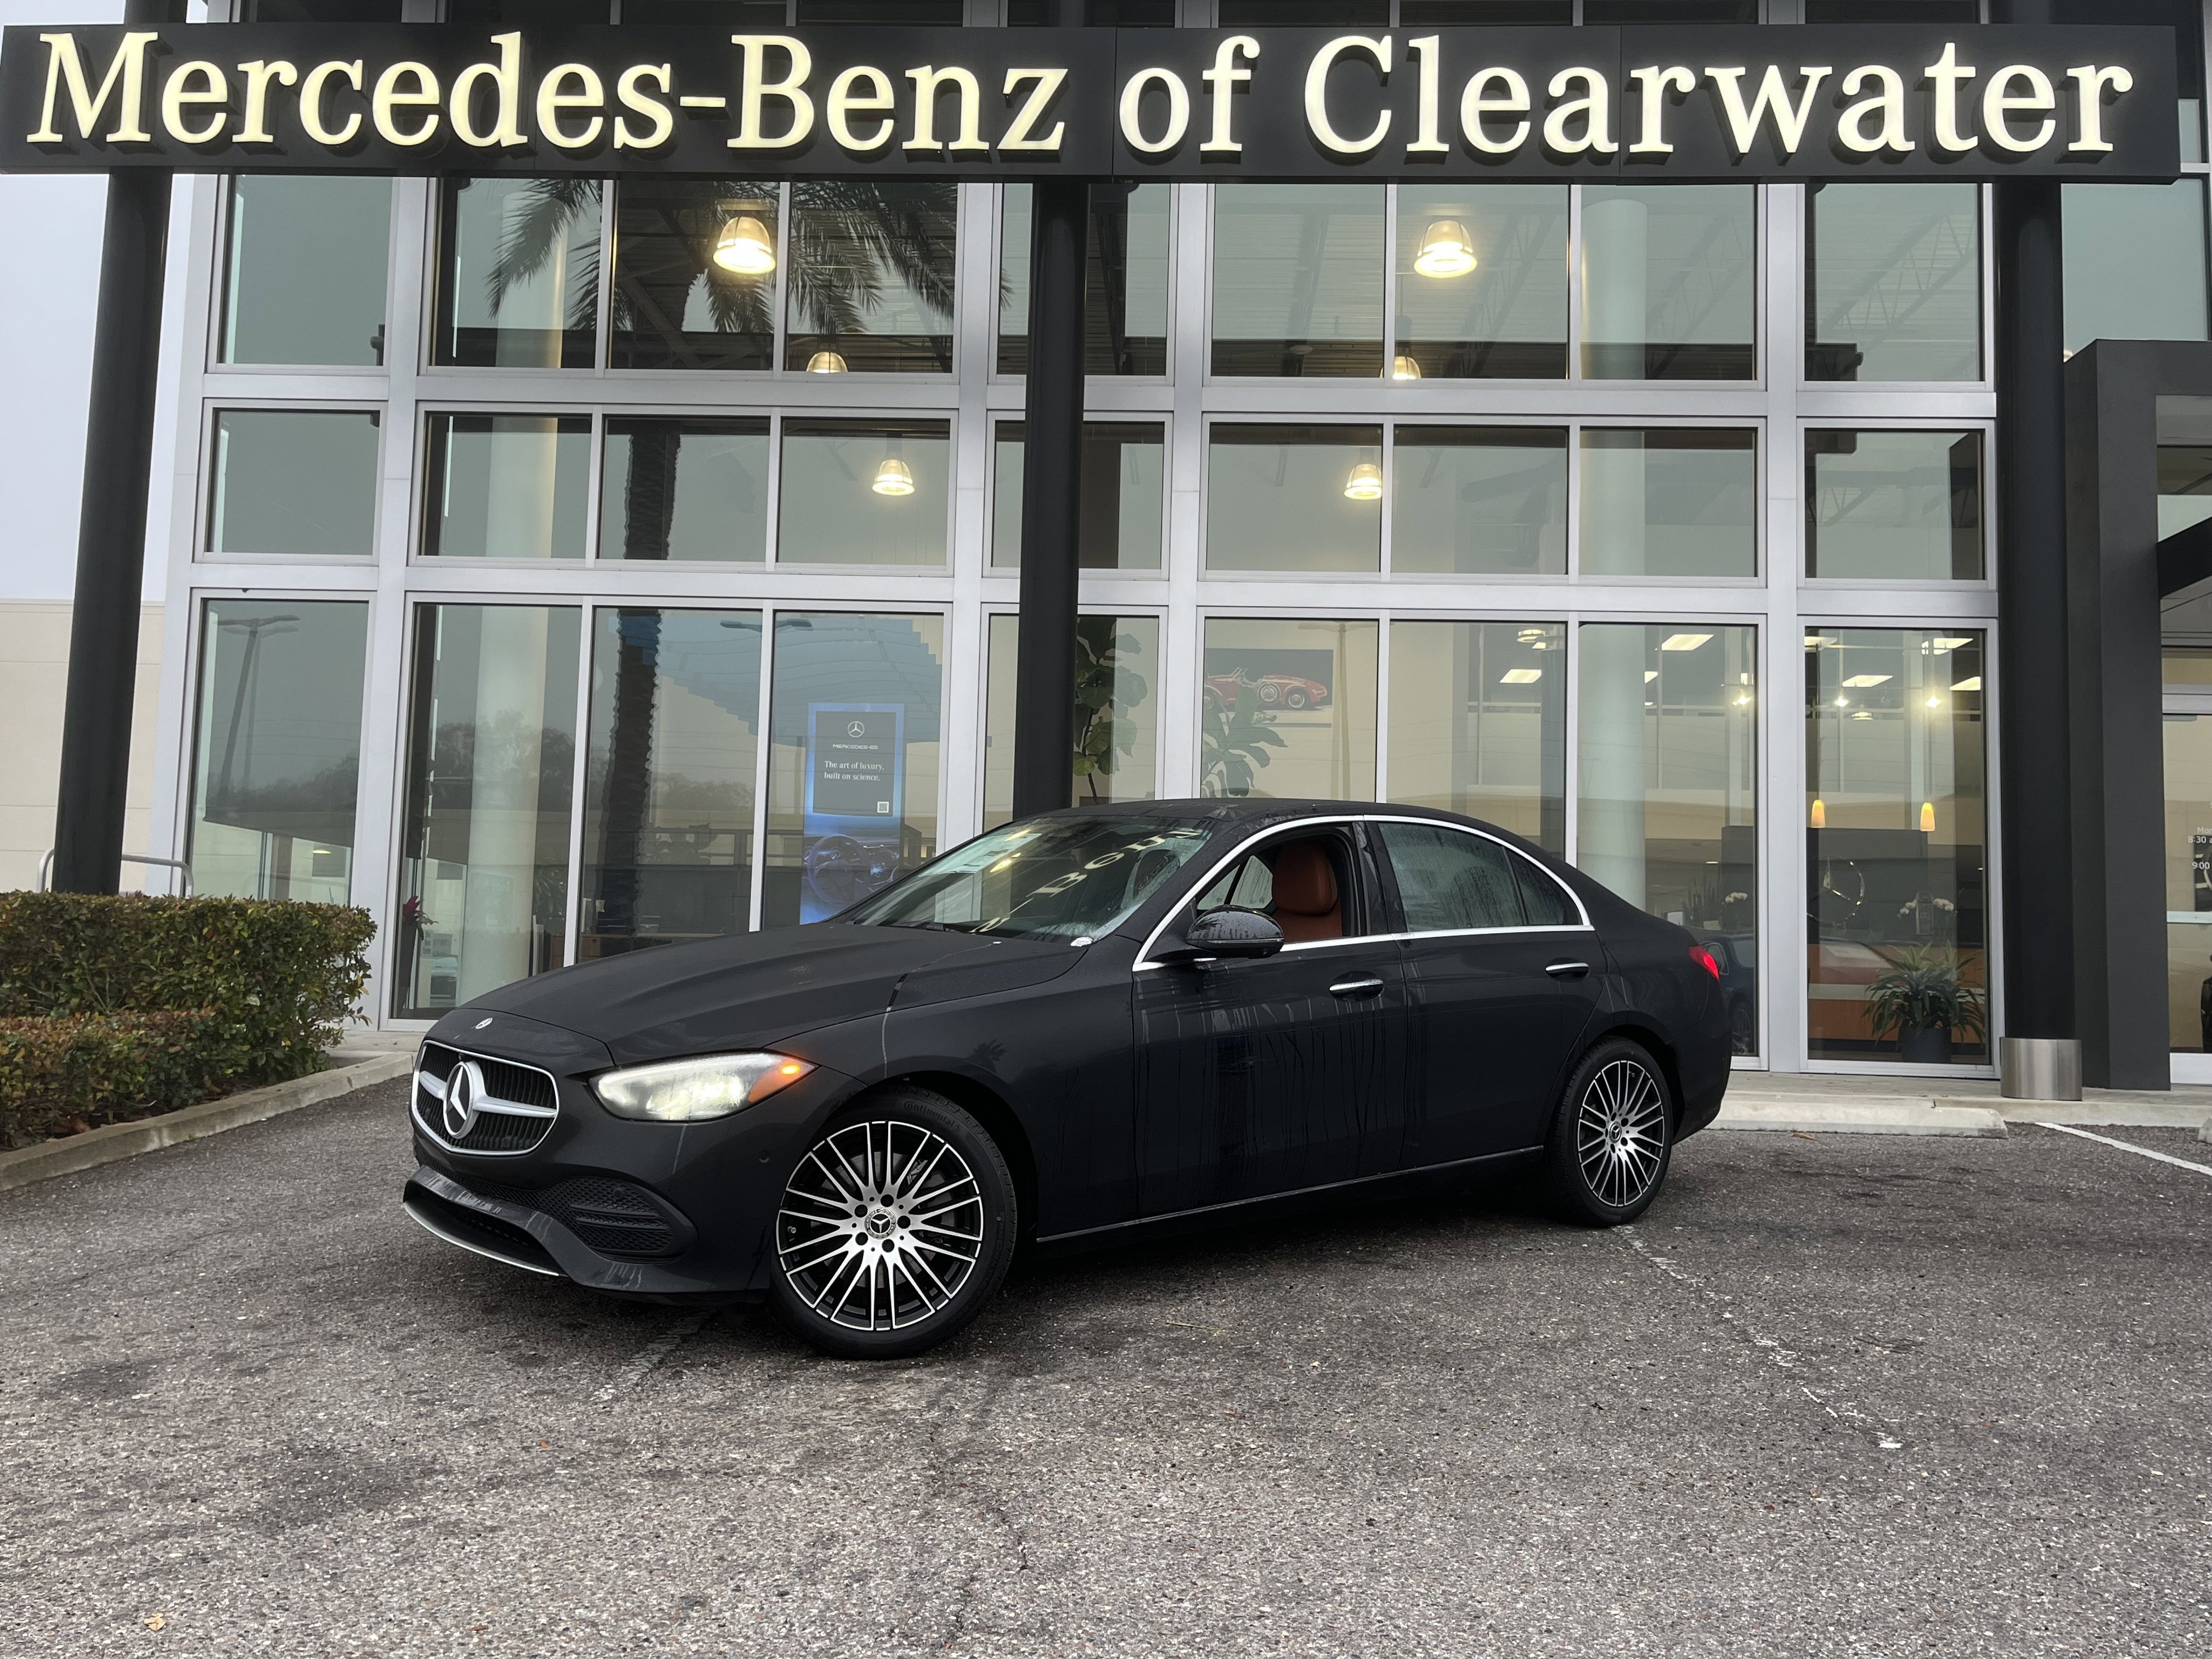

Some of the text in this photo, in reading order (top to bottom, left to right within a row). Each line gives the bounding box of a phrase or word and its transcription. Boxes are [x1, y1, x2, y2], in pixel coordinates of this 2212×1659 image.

[27, 31, 2134, 154] Mercedes-Benz of Clearwater
[860, 762, 884, 771] luxury,
[904, 1101, 955, 1127] Continental
